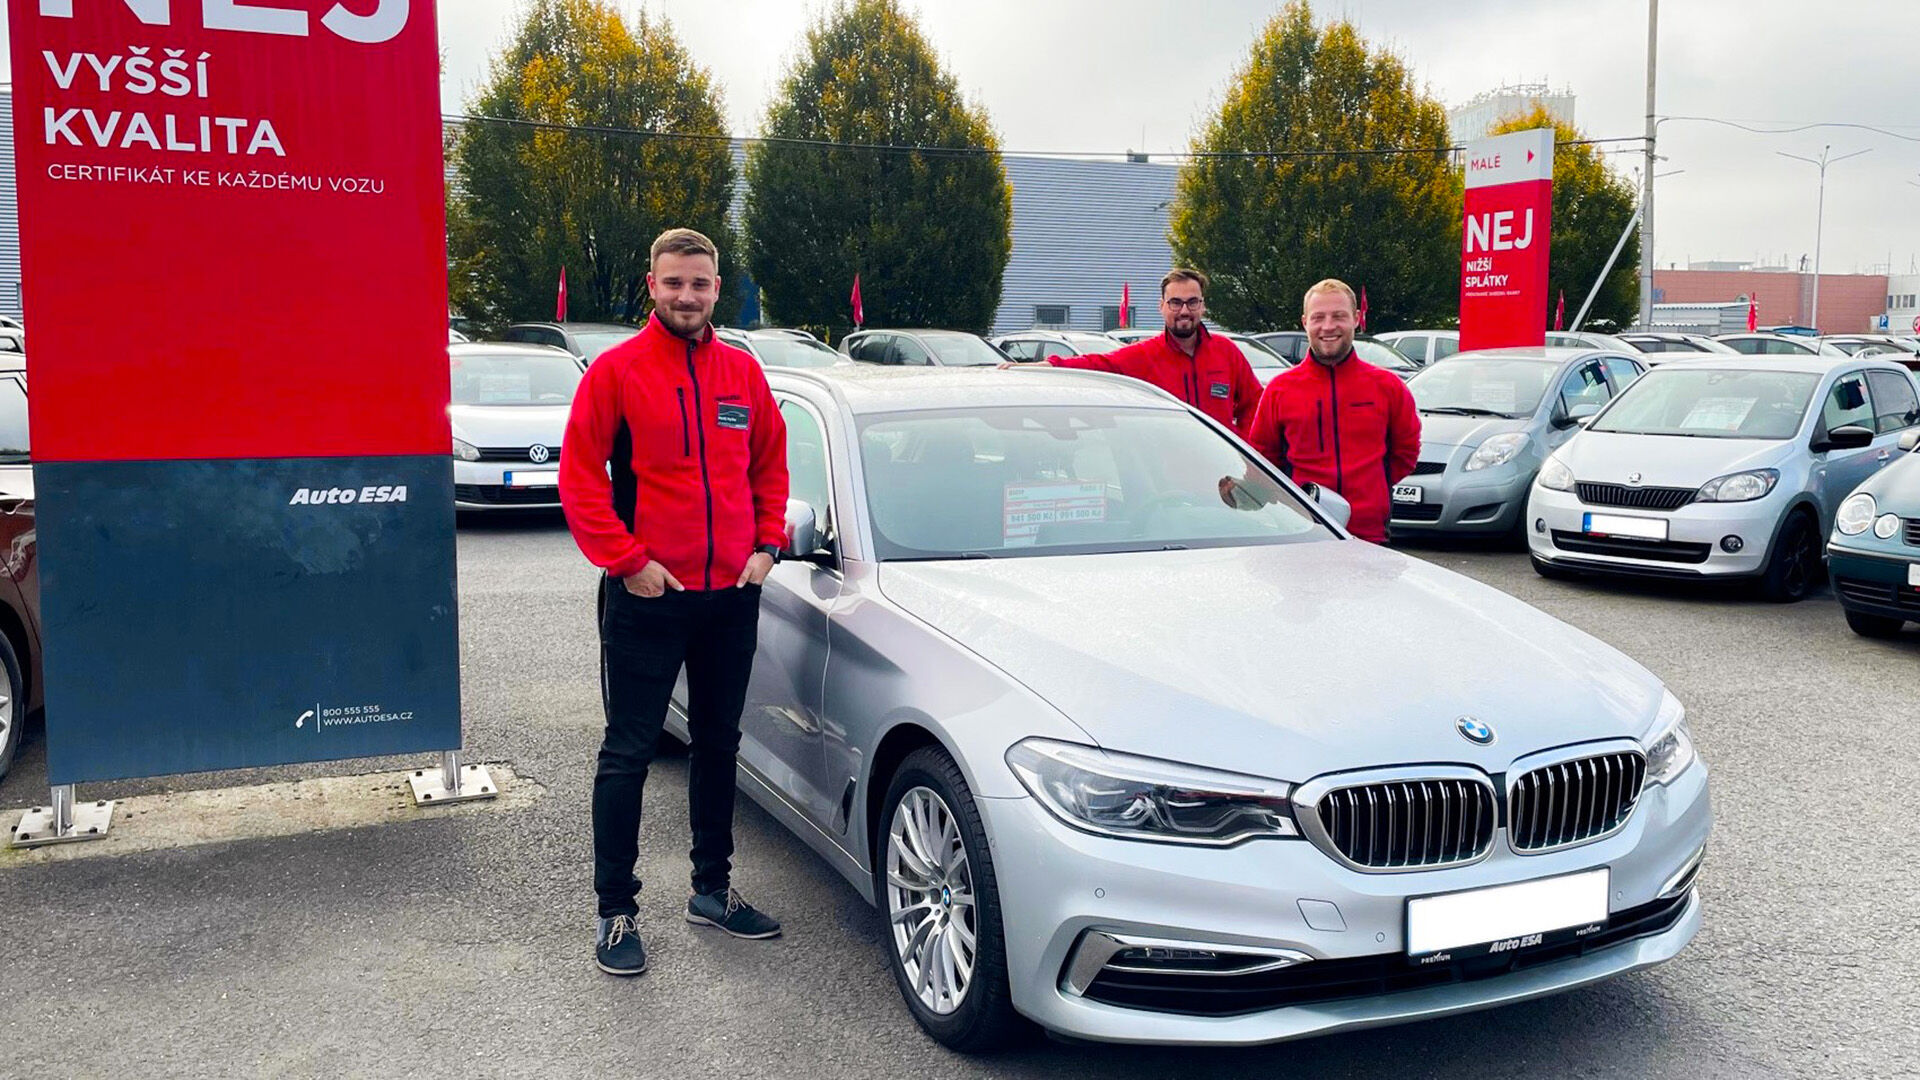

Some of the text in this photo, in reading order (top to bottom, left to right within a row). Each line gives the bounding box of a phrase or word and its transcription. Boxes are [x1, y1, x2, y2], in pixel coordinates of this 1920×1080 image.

[42, 45, 213, 98] VYŠŠÍ
[44, 107, 287, 157] KVALITA
[47, 163, 385, 194] CERTIFIKÁT KE KAŽDÉMU VOZU
[1466, 208, 1534, 253] NEJ
[1466, 257, 1492, 272] NIŽŠÍ
[1465, 274, 1509, 288] SPLÁTKY
[289, 486, 407, 505] Auto ESA
[1396, 487, 1416, 496] ESA
[323, 705, 380, 717] 800 555 555
[323, 711, 413, 726] WWW.AUTOESA.CZ
[1421, 925, 1601, 964] PREMIUM Auto ESA PREMIUM
